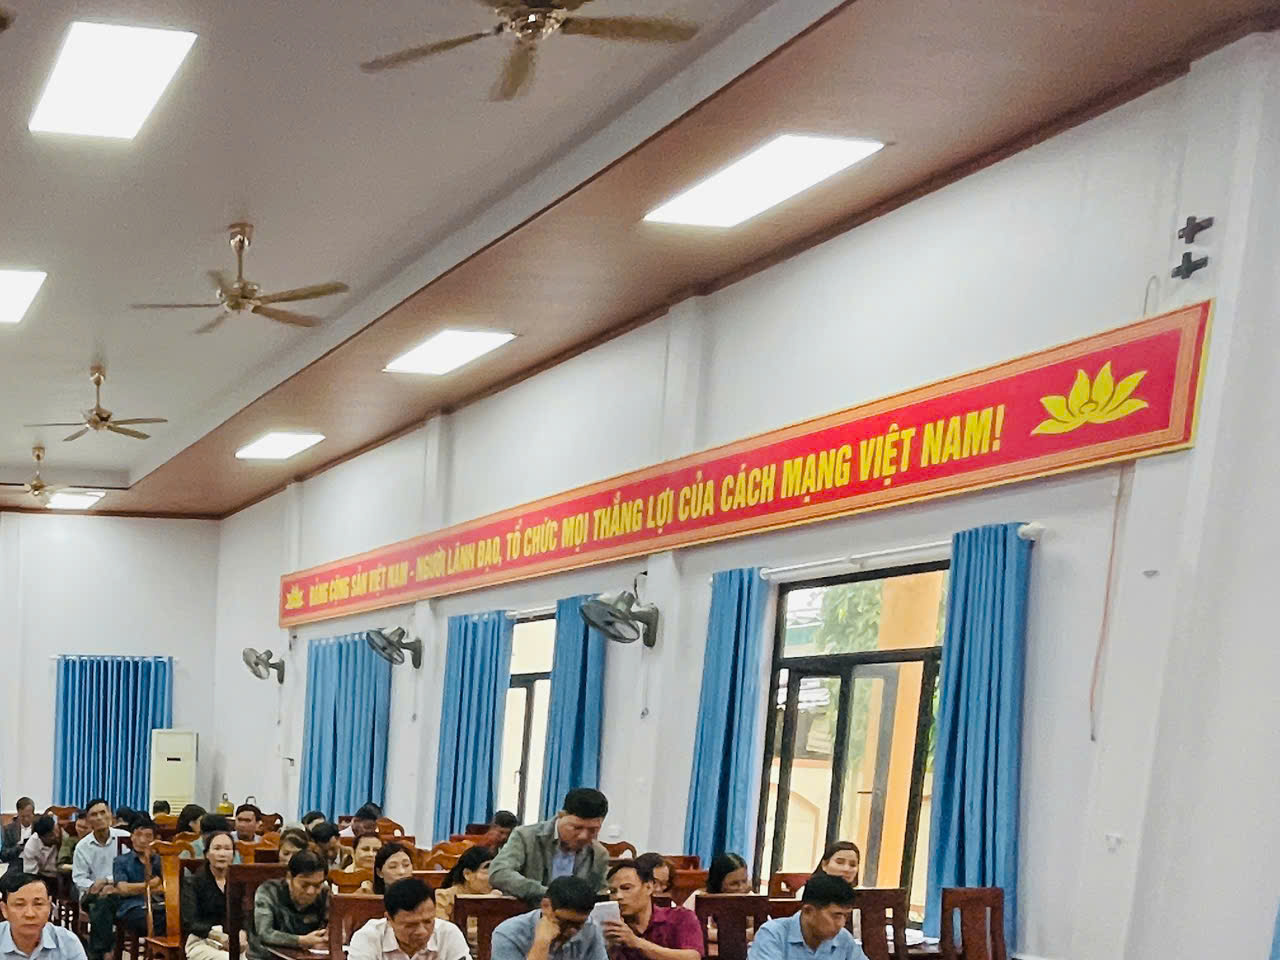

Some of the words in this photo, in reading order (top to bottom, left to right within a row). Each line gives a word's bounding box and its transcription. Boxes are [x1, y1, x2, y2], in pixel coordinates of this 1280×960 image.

[369, 563, 386, 597] VIỆT
[387, 561, 408, 588] NAM
[447, 540, 474, 576] LÃNH
[506, 519, 523, 560] TỔ
[523, 518, 558, 556] CHỨC
[561, 512, 590, 553] MỌI
[593, 491, 643, 541] THẮNG
[647, 487, 674, 535] LỢI
[677, 470, 715, 520] CỦA
[719, 461, 777, 513] CÁCH
[780, 444, 852, 504] MẠNG
[858, 422, 915, 487] VIỆT
[921, 403, 1005, 467] NAM!
